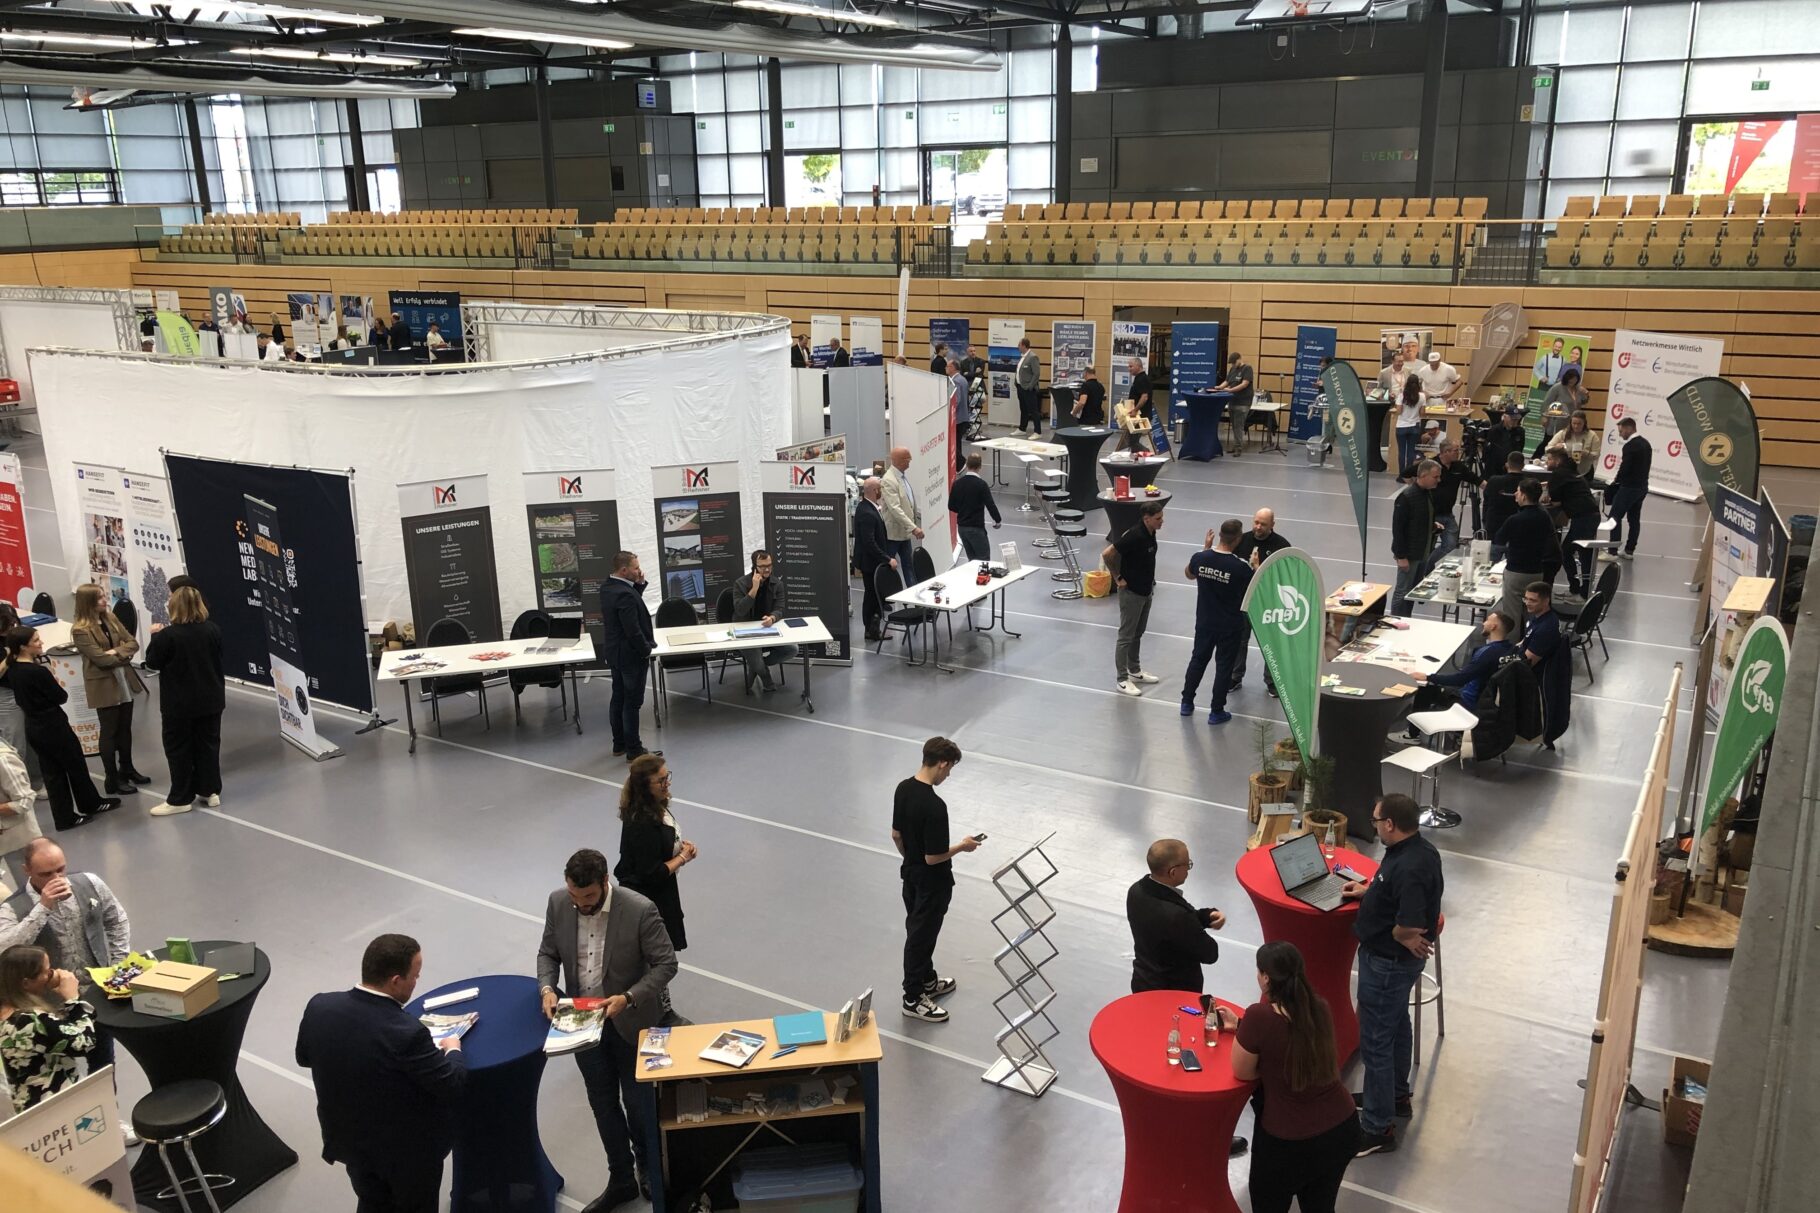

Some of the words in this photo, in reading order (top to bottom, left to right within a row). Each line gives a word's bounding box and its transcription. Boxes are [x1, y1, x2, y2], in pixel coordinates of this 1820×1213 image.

[216, 293, 230, 328] AKO
[1115, 324, 1135, 334] S&D
[1632, 339, 1678, 350] Netzwerkmesse
[1679, 344, 1702, 353] Wittlich
[416, 525, 441, 534] UNSERE
[441, 520, 480, 531] LEISTUNGEN
[1723, 506, 1756, 535] PARTNER
[238, 541, 254, 555] NEW
[240, 555, 256, 568] MED
[242, 568, 257, 581] LAB
[1198, 566, 1231, 580] CIRCLE
[22, 1124, 70, 1153] UPPE
[43, 1138, 73, 1164] CH
